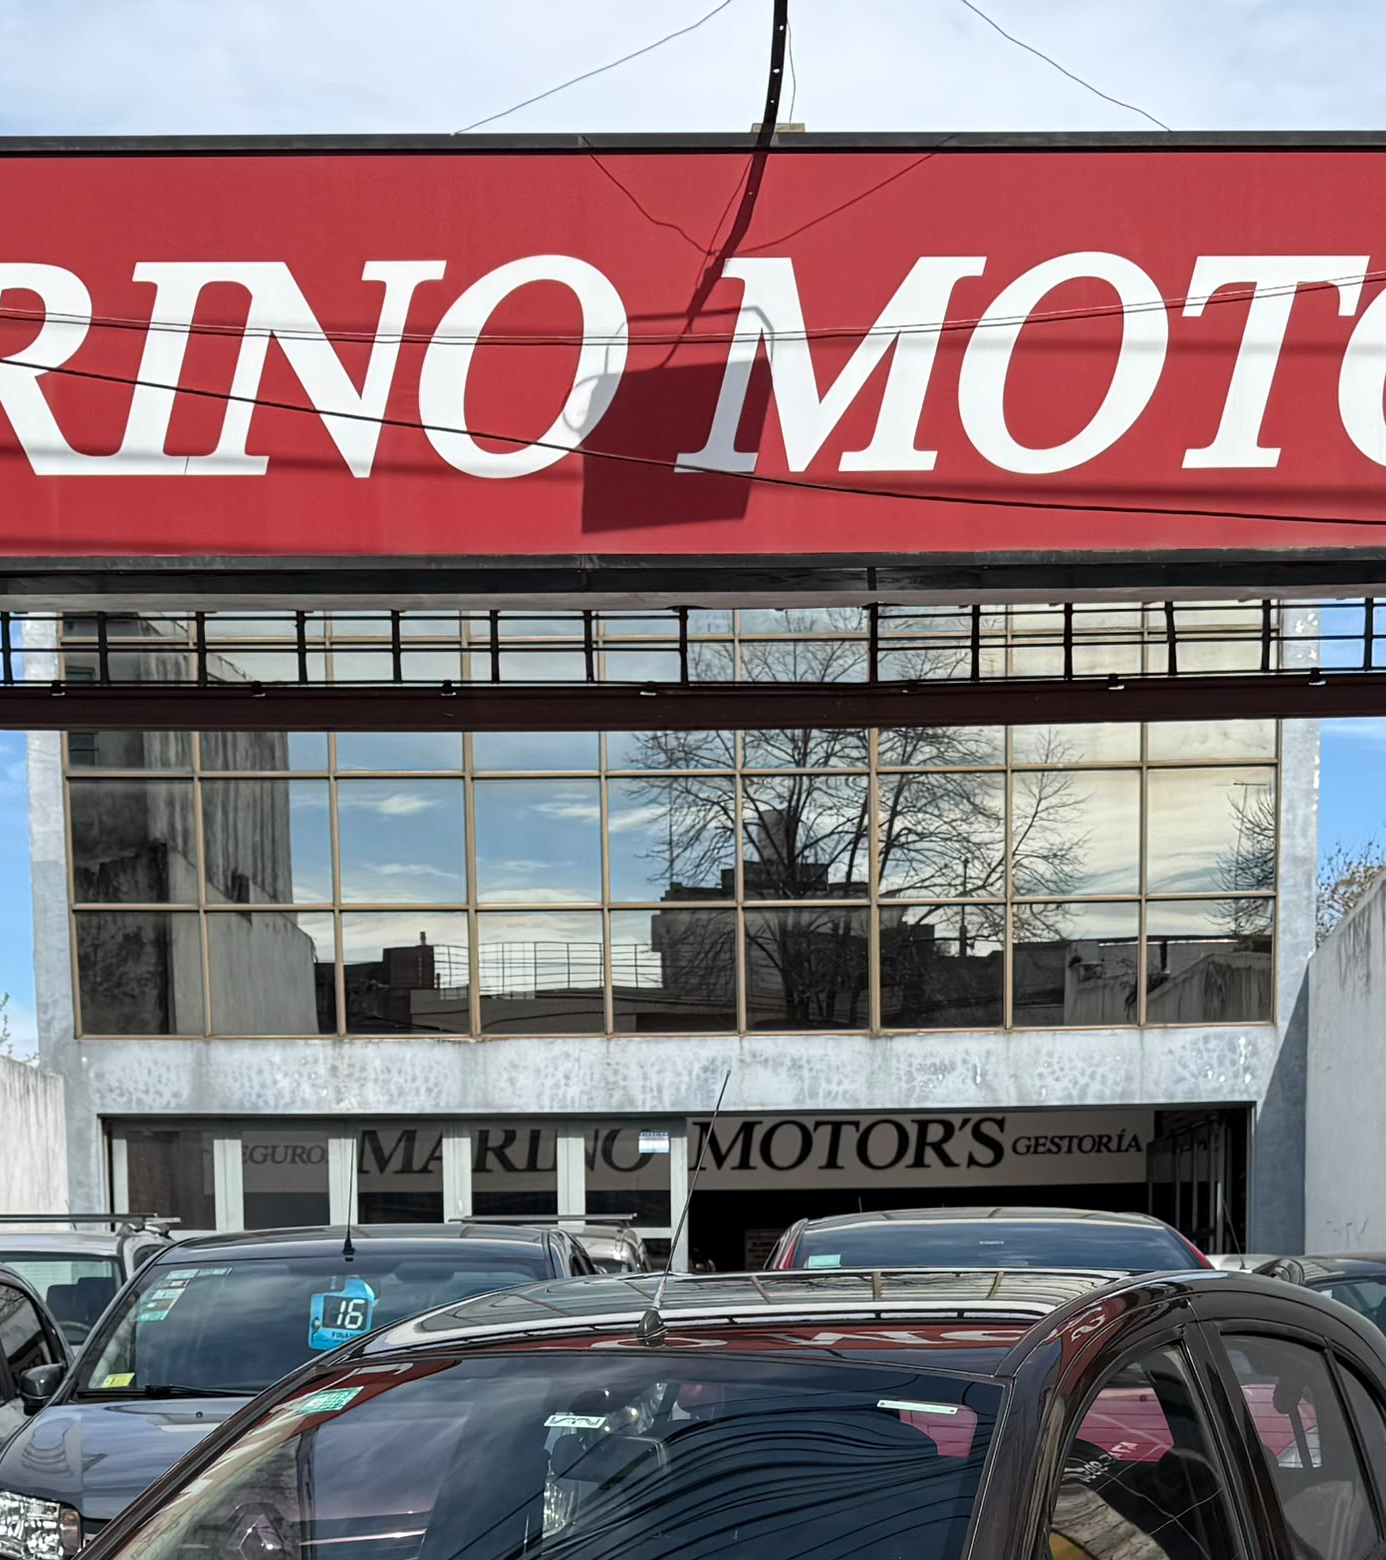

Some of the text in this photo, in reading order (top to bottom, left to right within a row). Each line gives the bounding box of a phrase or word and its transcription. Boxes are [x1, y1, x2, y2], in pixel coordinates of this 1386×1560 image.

[688, 1116, 1006, 1172] MOTOR'S
[1013, 1129, 1142, 1156] GESTORÍA
[336, 1298, 366, 1330] 16
